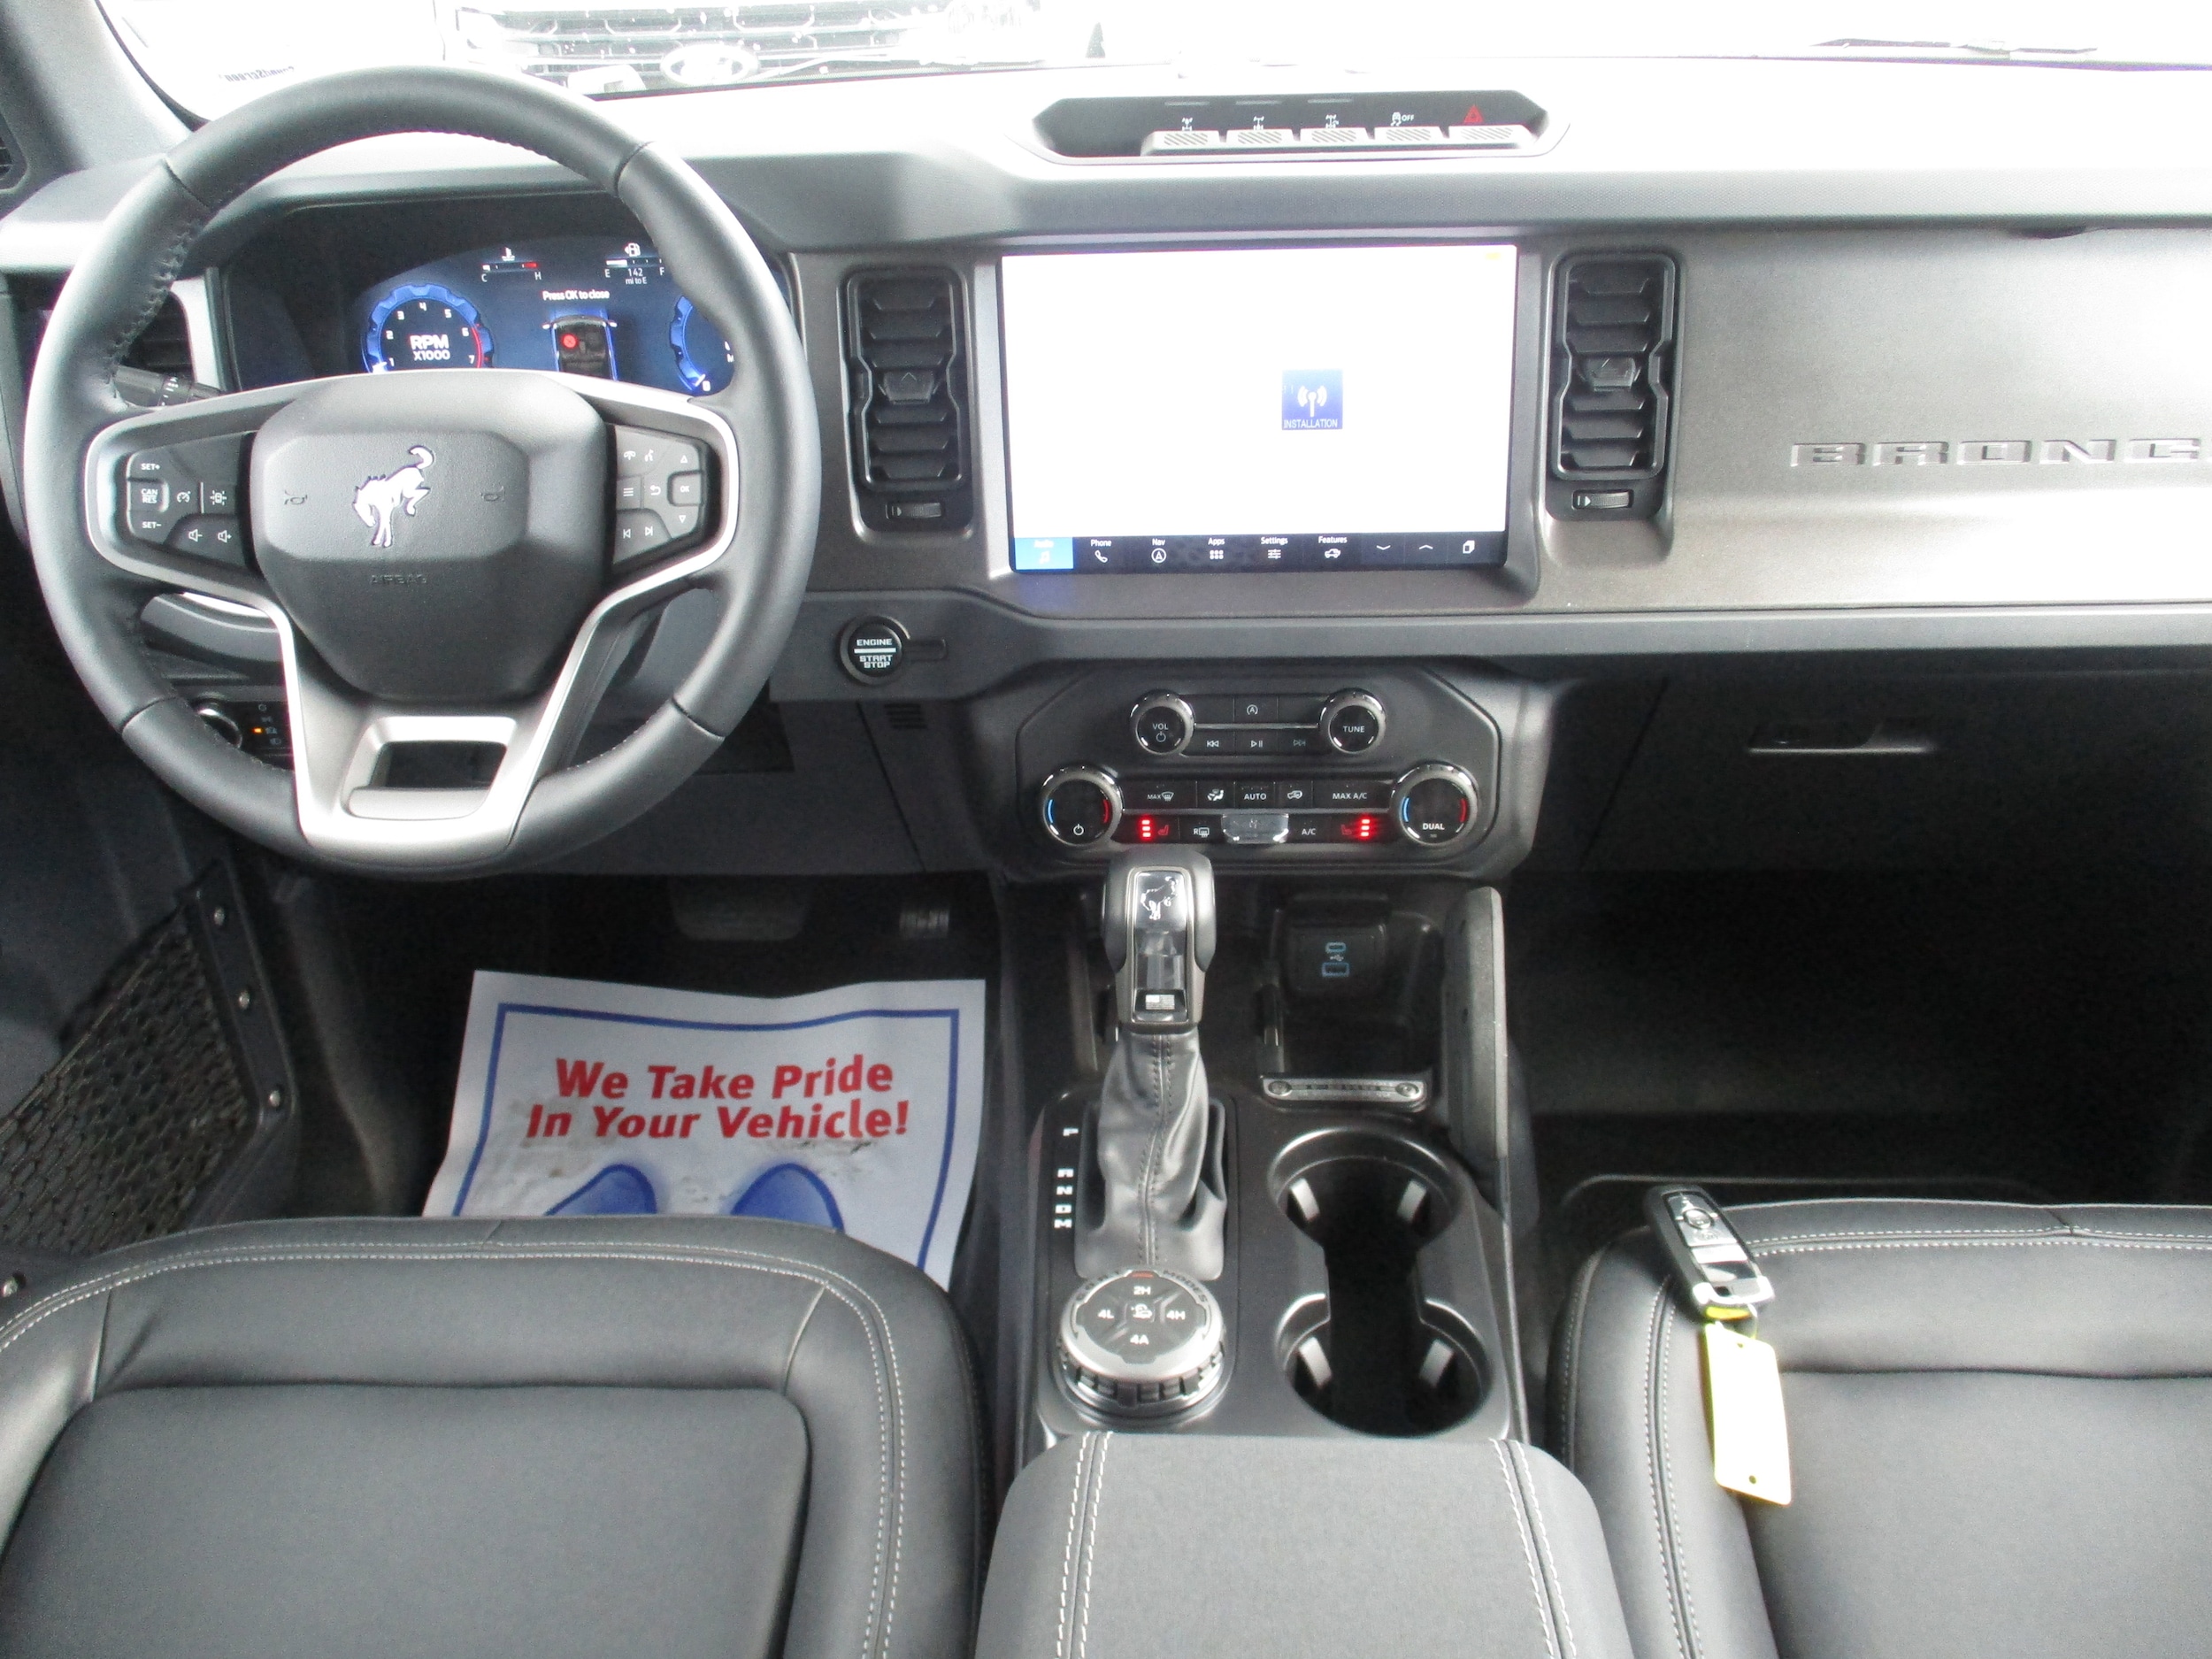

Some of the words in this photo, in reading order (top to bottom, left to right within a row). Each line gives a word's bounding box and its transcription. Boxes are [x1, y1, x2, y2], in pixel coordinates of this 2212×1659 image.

[534, 272, 542, 280] H
[604, 268, 611, 278] E
[628, 267, 643, 277] 142
[659, 266, 665, 276] F
[481, 273, 488, 282] C
[641, 276, 648, 285] E
[542, 290, 565, 301] Press
[565, 289, 578, 300] OK
[578, 290, 588, 300] to
[419, 302, 427, 311] 4
[396, 311, 405, 320] 3
[444, 309, 452, 319] 5
[385, 330, 394, 340] 2
[461, 326, 470, 337] 6
[409, 334, 449, 350] RPM
[388, 357, 395, 367] 1
[468, 355, 475, 364] 7
[1284, 419, 1339, 429] INSTALLATION
[1790, 438, 2212, 467] BRONC
[1090, 538, 1112, 548] Phone
[1152, 537, 1166, 547] Nav
[1208, 537, 1225, 547] Apps
[1260, 536, 1288, 546] Settings
[1317, 535, 1348, 545] Features
[856, 638, 893, 647] ENGINE
[859, 654, 893, 663] START
[1152, 722, 1169, 732] VOL
[1342, 725, 1365, 733] TUNE
[1243, 792, 1267, 801] AUTO
[1422, 822, 1446, 831] DUAL
[556, 1058, 628, 1099] We
[647, 1065, 754, 1100] Take
[771, 1054, 894, 1100] Pride
[526, 1104, 572, 1139] In
[593, 1105, 702, 1139] Your
[717, 1099, 910, 1140] Vehicle!
[1056, 1186, 1073, 1195] N
[1055, 1203, 1072, 1214] D
[1054, 1219, 1073, 1229] M
[1133, 1286, 1151, 1295] 2H
[1097, 1310, 1115, 1319] 4L
[1166, 1310, 1187, 1320] 4H
[1129, 1334, 1149, 1346] 4A
